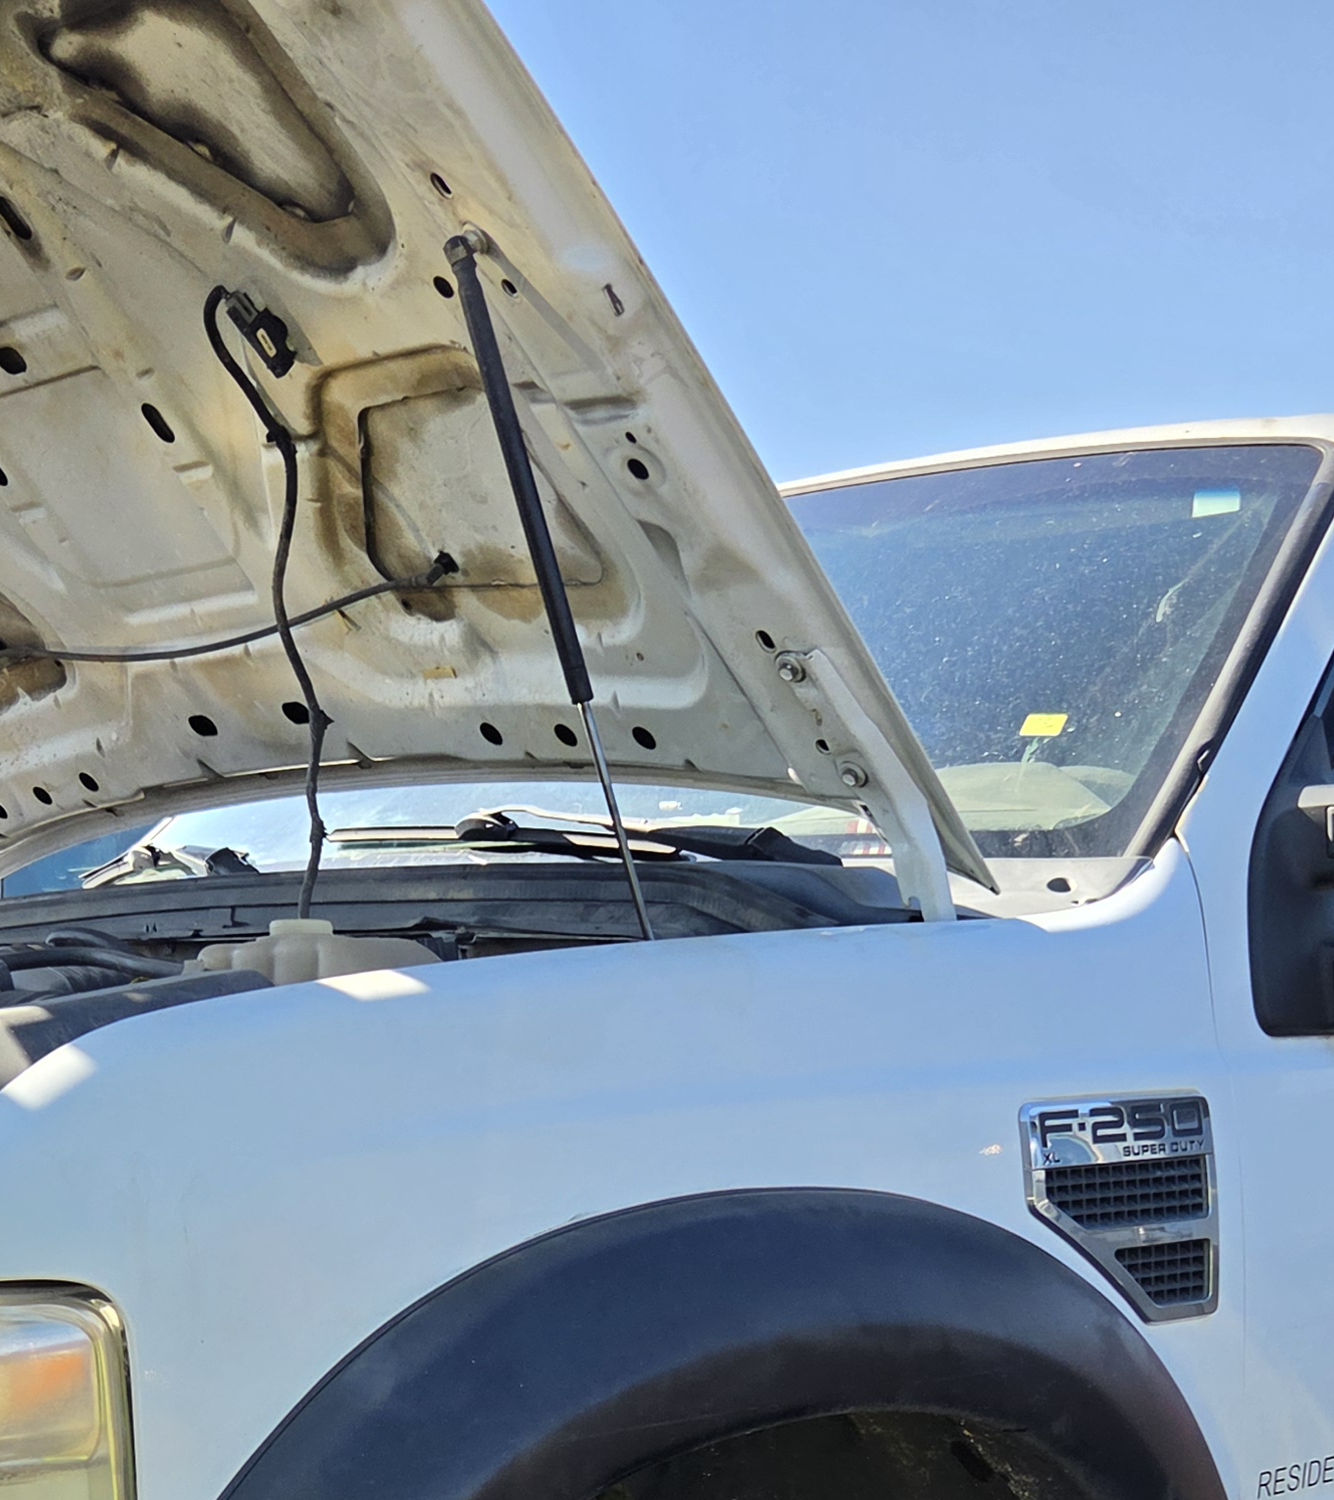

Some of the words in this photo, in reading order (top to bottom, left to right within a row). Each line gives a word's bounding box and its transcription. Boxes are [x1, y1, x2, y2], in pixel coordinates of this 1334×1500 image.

[1122, 1144, 1166, 1157] SUPER
[1172, 1139, 1206, 1153] DUTY
[1043, 1152, 1061, 1166] XL
